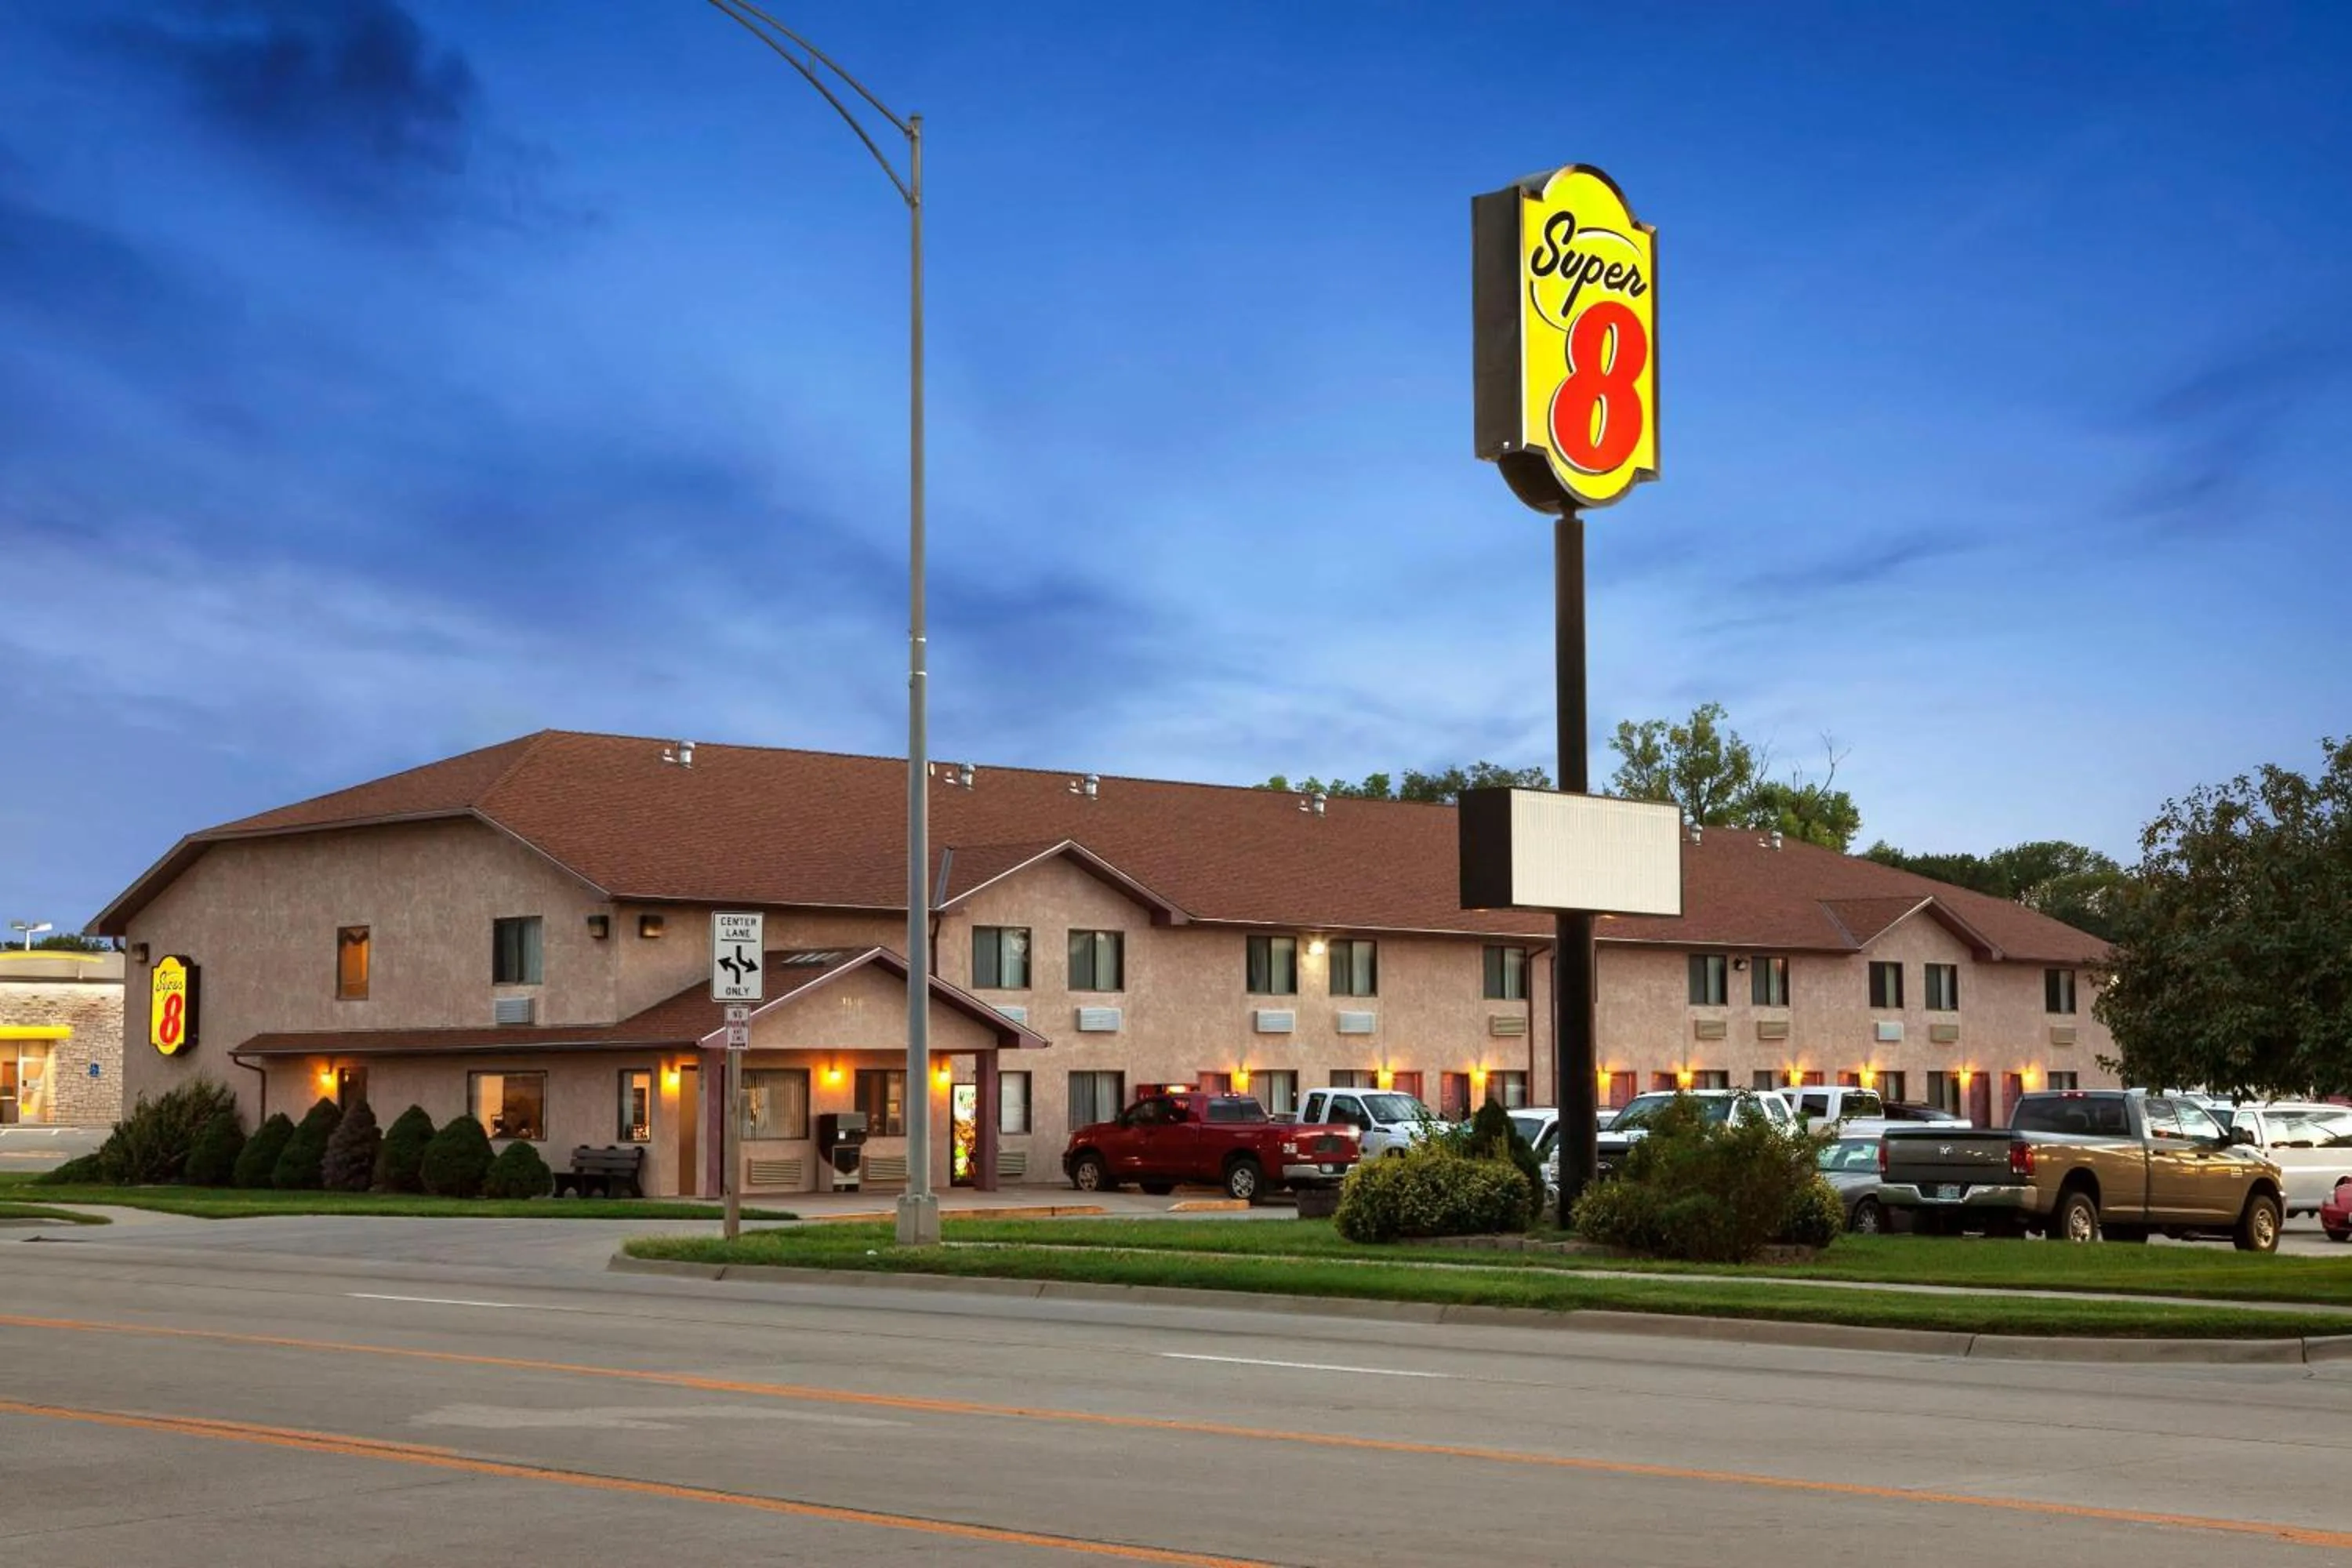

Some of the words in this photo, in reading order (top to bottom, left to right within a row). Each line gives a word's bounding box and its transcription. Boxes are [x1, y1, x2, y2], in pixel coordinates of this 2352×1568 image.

[1530, 210, 1648, 319] Super
[1551, 300, 1648, 473] 8
[720, 916, 757, 926] CENTER
[725, 929, 751, 938] LANE
[155, 971, 183, 1002] Super
[725, 986, 750, 996] ONLY
[159, 993, 183, 1045] 8
